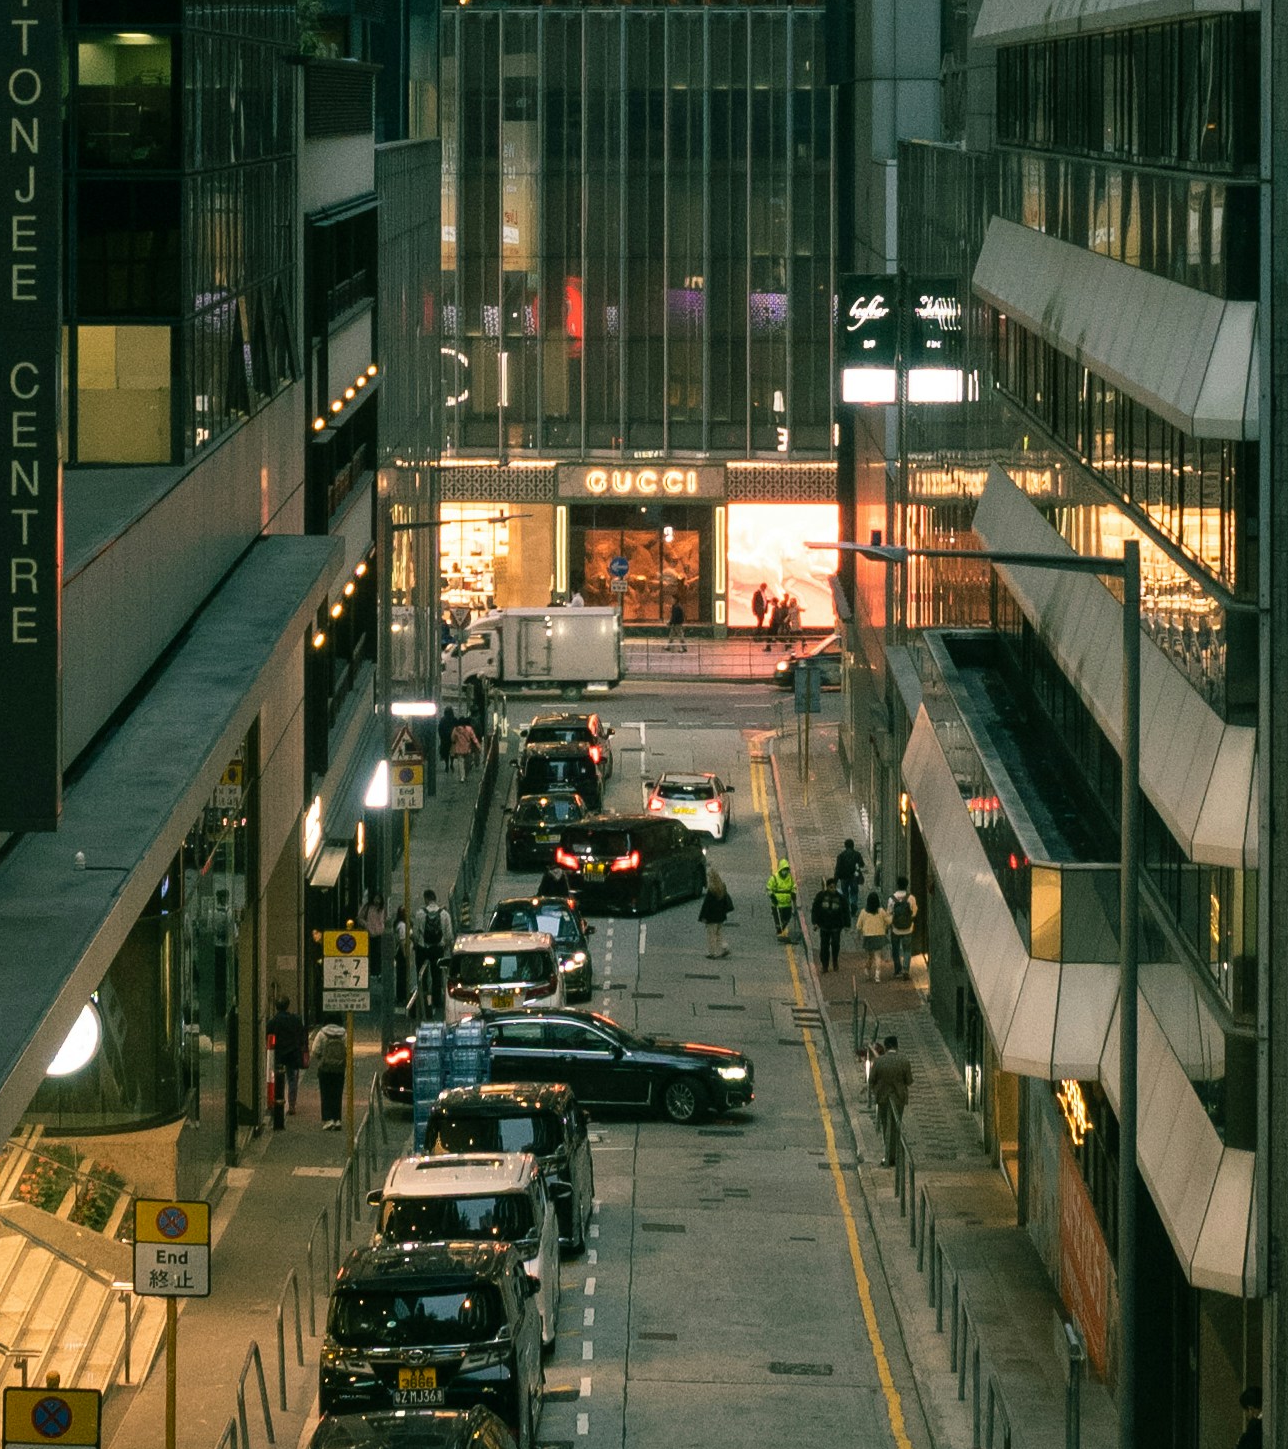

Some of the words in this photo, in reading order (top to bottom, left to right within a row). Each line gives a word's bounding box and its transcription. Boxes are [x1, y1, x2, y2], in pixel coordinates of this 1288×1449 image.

[586, 470, 697, 493] GUCCI
[10, 361, 40, 642] CENTRE
[352, 959, 361, 970] 7
[352, 975, 361, 987] 7
[156, 1249, 189, 1265] End
[149, 1268, 195, 1289] 終止
